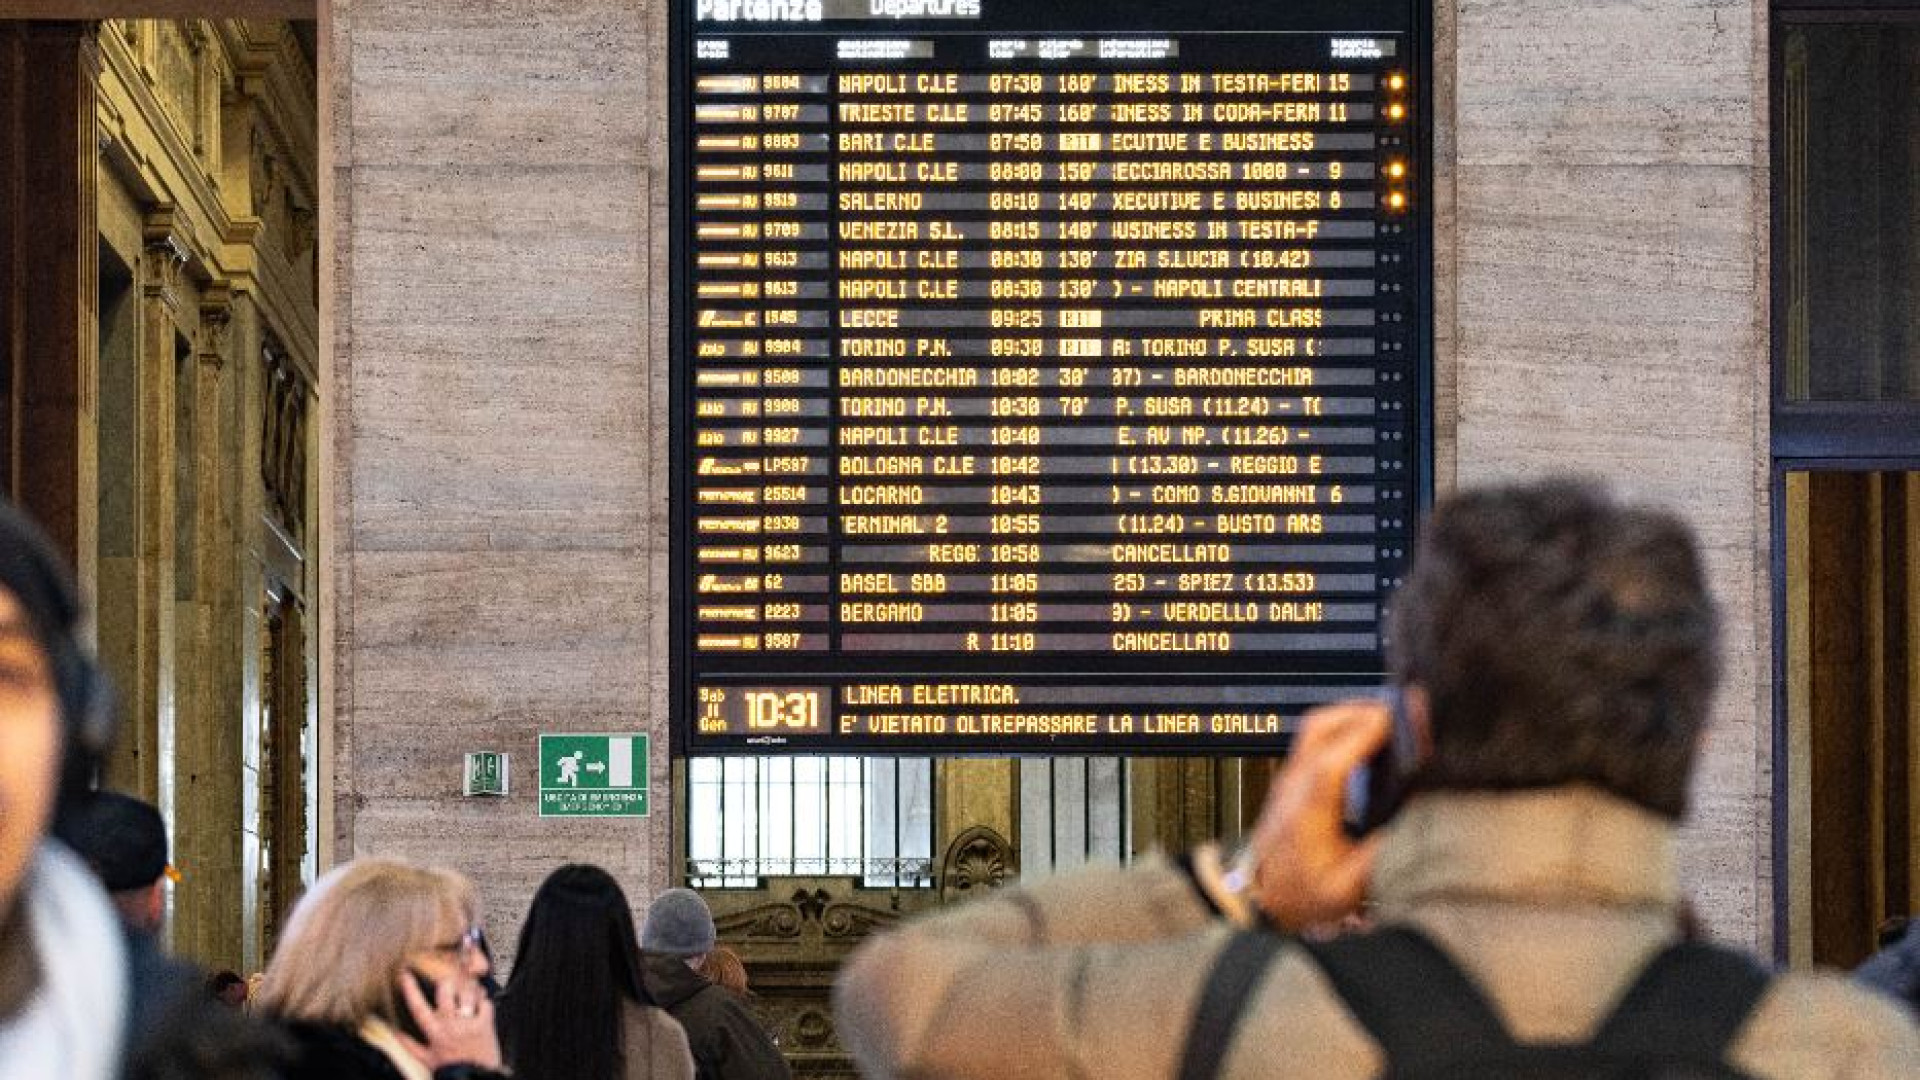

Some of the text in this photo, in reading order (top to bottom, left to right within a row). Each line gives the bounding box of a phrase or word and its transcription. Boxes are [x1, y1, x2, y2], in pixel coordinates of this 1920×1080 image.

[839, 73, 907, 93] NAPOLI
[917, 73, 958, 93] C.LE
[989, 73, 1042, 93] 07:30
[1180, 73, 1201, 93] IN
[1329, 73, 1351, 93] 15
[839, 102, 915, 122] TRIESTE
[927, 102, 968, 122] C.LE
[989, 102, 1042, 122] 07:45
[1182, 102, 1203, 122] IN
[1329, 102, 1347, 122] 11
[839, 133, 884, 151] BARI
[893, 133, 935, 151] C.LE
[989, 133, 1042, 151] 07:50
[1112, 133, 1188, 151] ECUTIVE
[1198, 133, 1211, 151] E
[1222, 133, 1314, 151] BUSINESS
[839, 162, 907, 182] NAPOLI
[917, 162, 958, 182] C.LE
[989, 162, 1042, 182] 08:00
[1112, 162, 1232, 182] ECCIAROSSA
[1242, 162, 1287, 182] 1000
[1328, 162, 1342, 182] 9
[839, 191, 923, 211] SALERNO
[989, 191, 1040, 211] 08:10
[1213, 191, 1225, 211] E
[1236, 191, 1320, 211] BUSINES
[1329, 191, 1341, 211] 8
[839, 221, 919, 240] VENEZIA
[989, 221, 1040, 240] 08:15
[1112, 221, 1197, 240] USINESS
[1207, 221, 1228, 240] IN
[839, 250, 907, 268] NAPOLI
[917, 250, 958, 268] C.LE
[990, 250, 1043, 268] 08:30
[1114, 250, 1147, 268] ZIA
[1157, 250, 1230, 268] S.LUCIA
[1240, 250, 1310, 268] (10.42)
[839, 279, 907, 299] NAPOLI
[917, 279, 958, 299] C.LE
[990, 279, 1043, 299] 08:30
[1153, 279, 1223, 299] NAPOLI
[840, 309, 898, 328] LECCE
[991, 309, 1043, 328] 09:25
[1199, 309, 1256, 328] PRIMA
[841, 338, 906, 357] TORINO
[917, 338, 952, 357] P.N.
[991, 338, 1043, 357] 09:30
[1141, 338, 1207, 357] TORINO
[1218, 338, 1238, 357] P.
[1246, 338, 1295, 357] SUSA
[839, 367, 978, 386] BARDONECCHIA
[991, 367, 1040, 386] 10:02
[1174, 367, 1314, 386] BARDONECCHIA
[840, 396, 907, 416] TORINO
[916, 396, 952, 416] P.N.
[991, 396, 1041, 416] 10:30
[1115, 396, 1133, 416] P.
[1143, 396, 1193, 416] SUSA
[1203, 396, 1270, 416] (11.24)
[839, 426, 908, 445] NAPOLI
[918, 426, 958, 445] C.LE
[991, 426, 1040, 445] 10:40
[1145, 426, 1170, 445] AV
[1221, 426, 1289, 445] (11.26)
[839, 456, 923, 474] BOLOGNA
[933, 456, 975, 474] C.LE
[991, 456, 1040, 474] 10:42
[1128, 456, 1199, 474] (13.30)
[1230, 456, 1298, 474] REGGIO
[1308, 456, 1322, 474] E
[839, 485, 923, 505] LOCARNO
[991, 485, 1040, 505] 10:43
[1151, 485, 1201, 505] COMO
[1211, 485, 1316, 505] S.GIOVANNI
[1330, 485, 1343, 505] 6
[935, 514, 948, 534] 2
[991, 514, 1040, 534] 10:55
[1118, 514, 1184, 534] (11.24)
[1217, 514, 1275, 534] BUSTO
[1287, 514, 1322, 534] ARS
[928, 544, 981, 563] REGG
[1112, 544, 1230, 563] CANCELLATO
[841, 573, 898, 593] BASEL
[910, 573, 946, 593] SBB
[991, 573, 1038, 593] 11:05
[1178, 573, 1234, 593] SPIEZ
[1244, 573, 1314, 593] (13.53)
[841, 602, 923, 622] BERGAMO
[991, 602, 1038, 622] 11:05
[1164, 602, 1259, 622] VERDELLO
[1269, 602, 1322, 622] DALM
[991, 633, 1034, 651] 11:10
[1112, 633, 1230, 651] CANCELLATO
[846, 684, 1020, 704] LINEA ELETTRICA.
[744, 692, 818, 729] 10:31
[868, 715, 946, 733] VIETATO
[956, 715, 1098, 733] OLTREPASSARE
[1108, 715, 1133, 733] LA
[1143, 715, 1200, 733] LINEA
[1211, 715, 1279, 733] GIALLA
